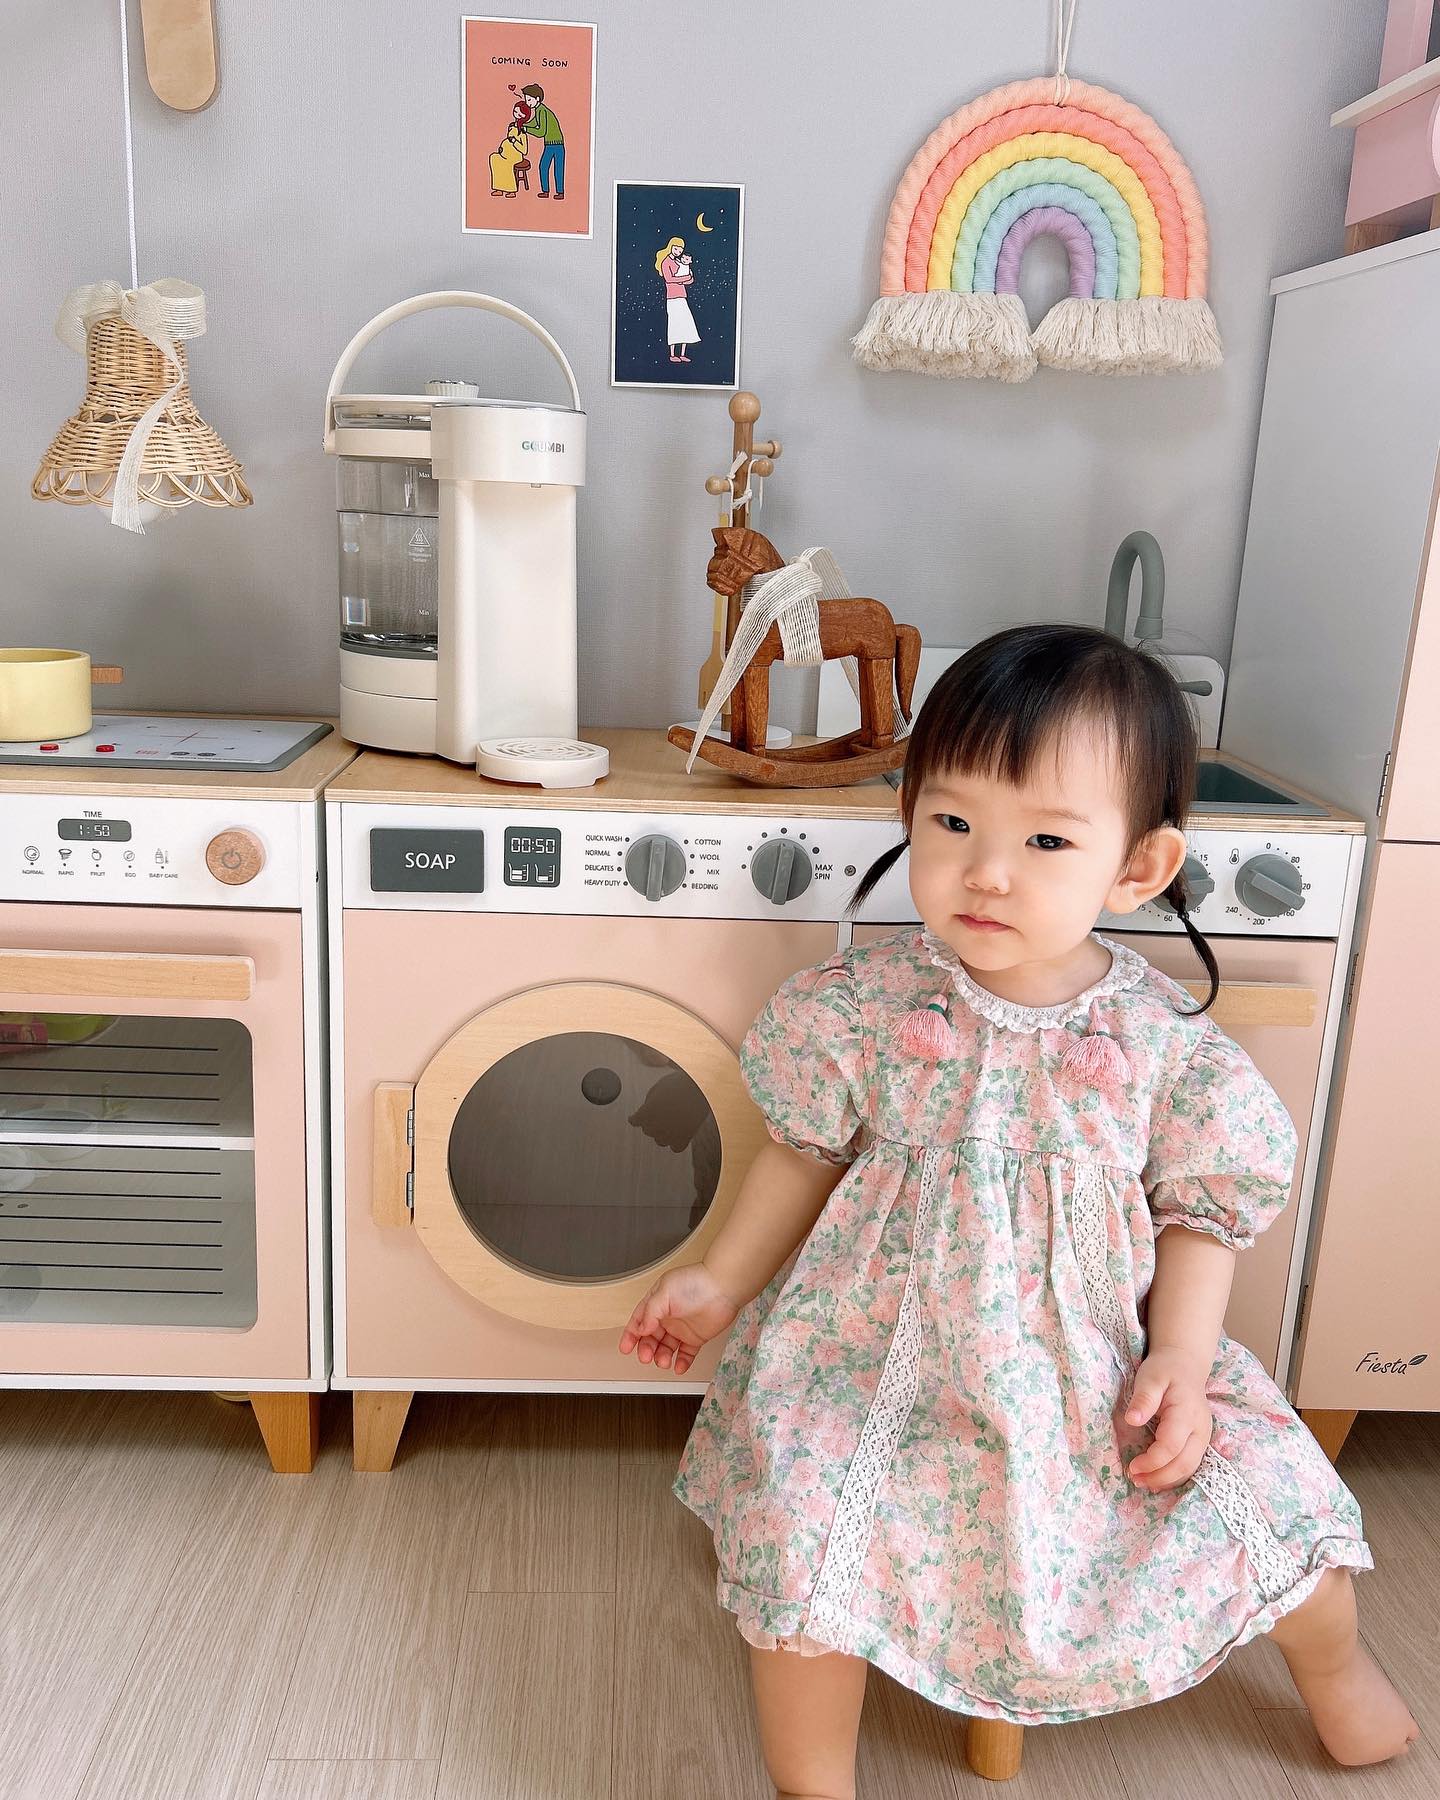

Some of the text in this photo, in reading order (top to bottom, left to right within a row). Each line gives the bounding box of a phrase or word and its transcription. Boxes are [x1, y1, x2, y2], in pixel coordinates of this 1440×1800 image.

[491, 56, 569, 68] COMING SOON
[83, 810, 103, 819] TIME
[585, 834, 604, 842] QUICK
[694, 838, 722, 846] COTTON
[511, 837, 556, 854] 00:50
[1265, 842, 1272, 850] 0
[404, 852, 456, 870] SOAP
[699, 853, 720, 861] WOOL
[1200, 854, 1209, 862] 15
[1290, 856, 1301, 864] 80
[584, 864, 614, 872] DELICATES
[814, 863, 834, 872] MAX
[814, 873, 831, 881] SPIN
[584, 879, 603, 887] HEAVY
[691, 883, 719, 891] BEDDING
[1225, 906, 1239, 914] 240
[1163, 914, 1173, 922] 60
[1252, 918, 1266, 926] 200
[1355, 1351, 1408, 1375] Fiesta
